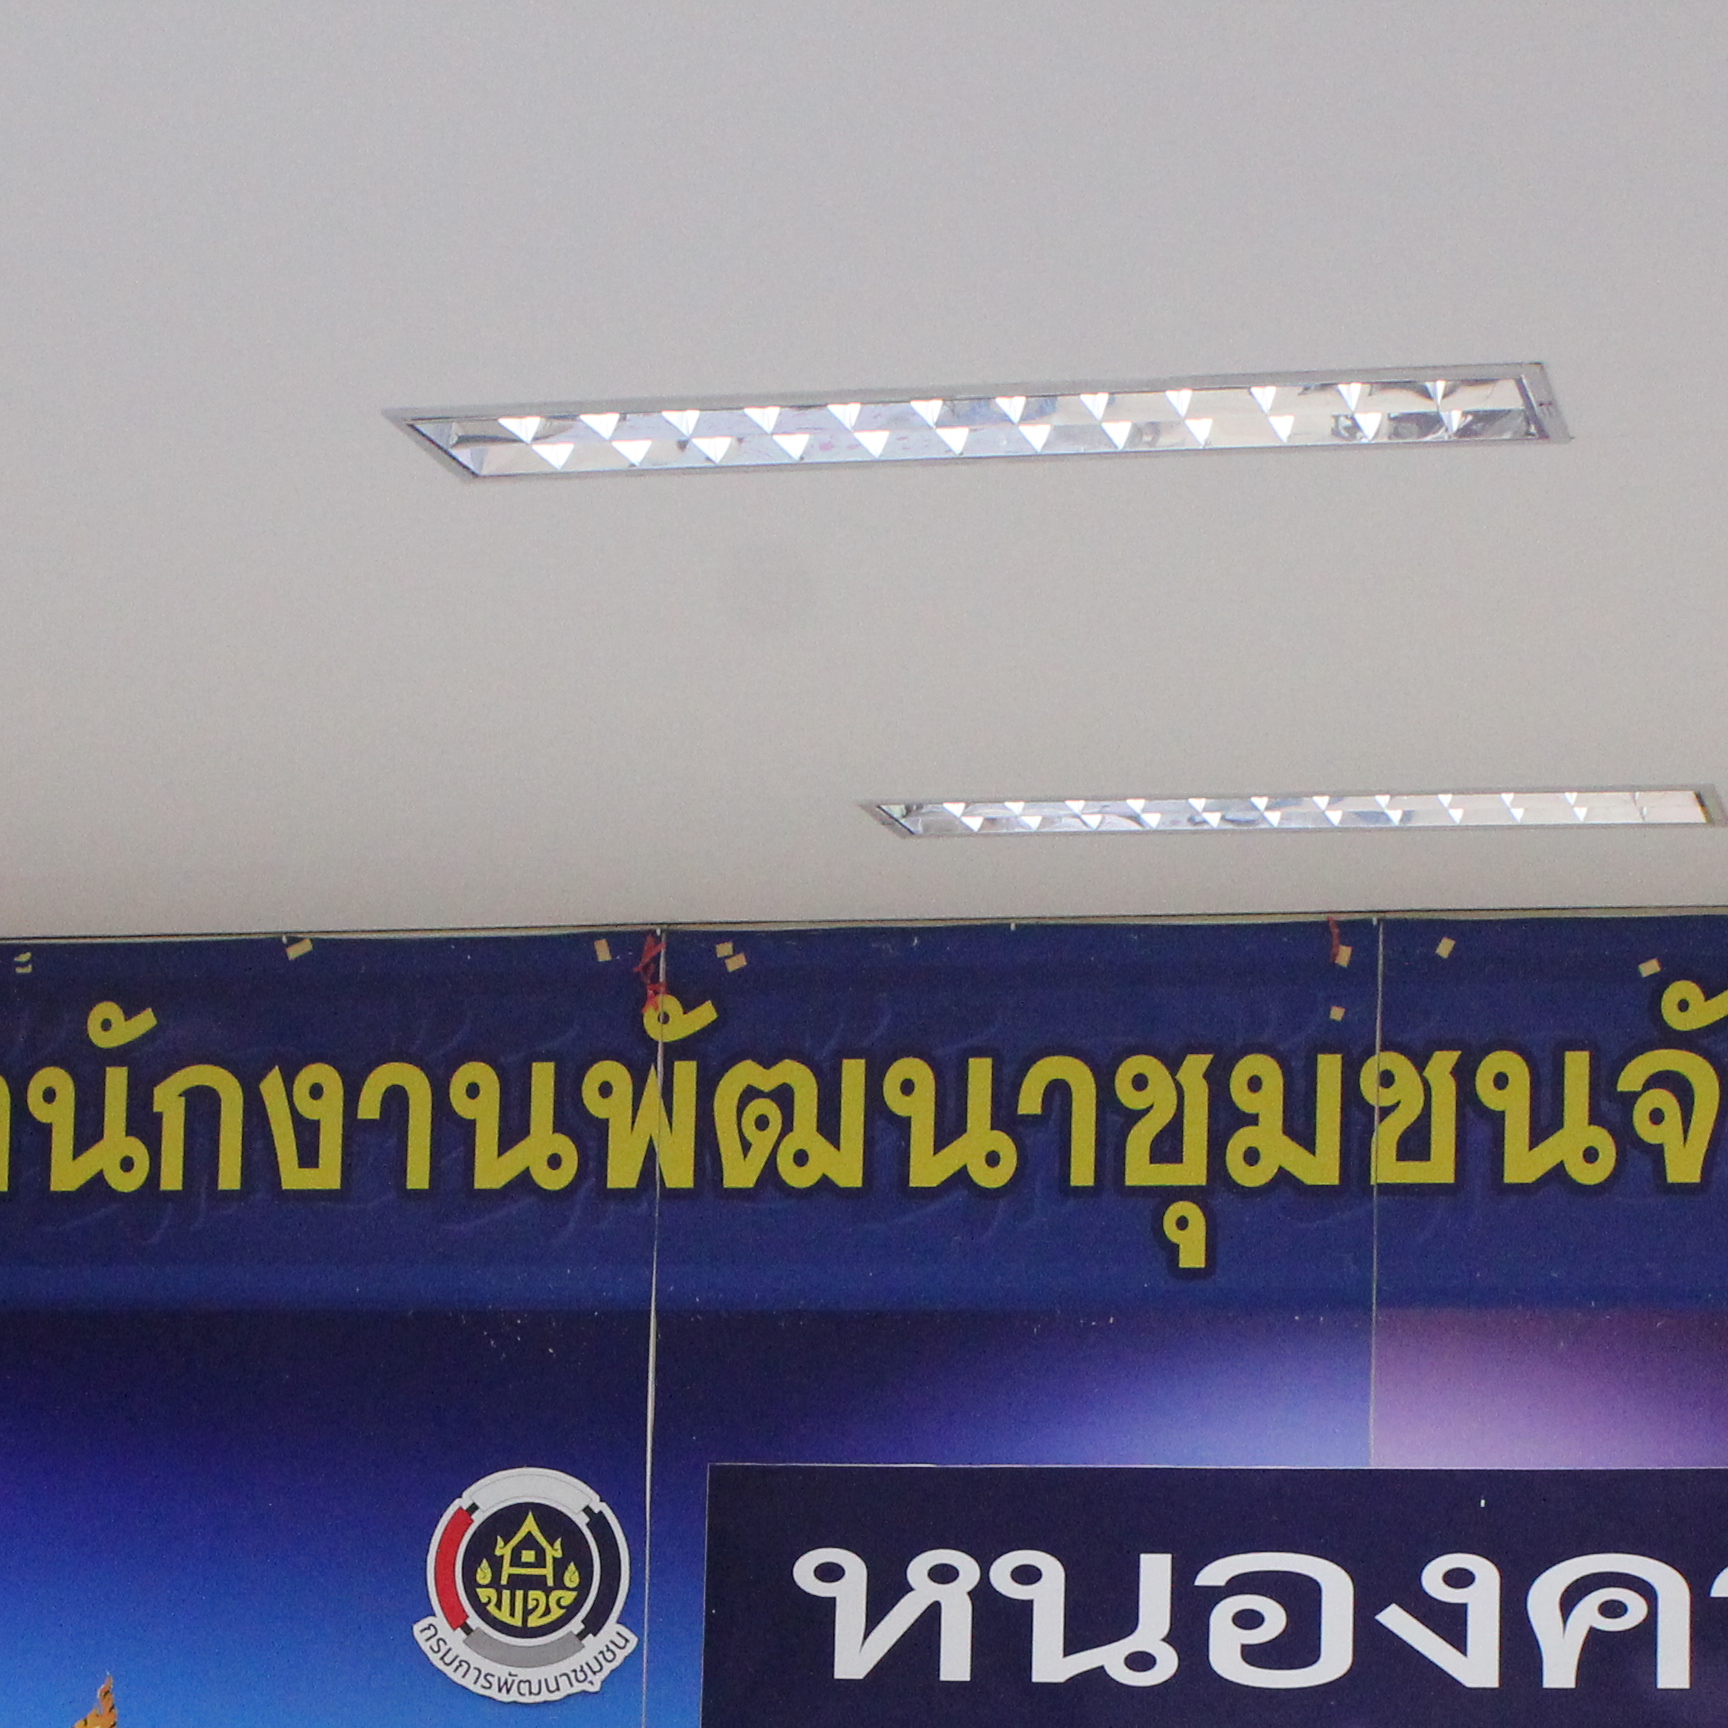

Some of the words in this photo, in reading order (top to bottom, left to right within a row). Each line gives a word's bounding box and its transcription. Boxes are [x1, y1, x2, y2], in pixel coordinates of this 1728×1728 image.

[417, 1623, 631, 1698] กรมการพัฒนาชุมชน
